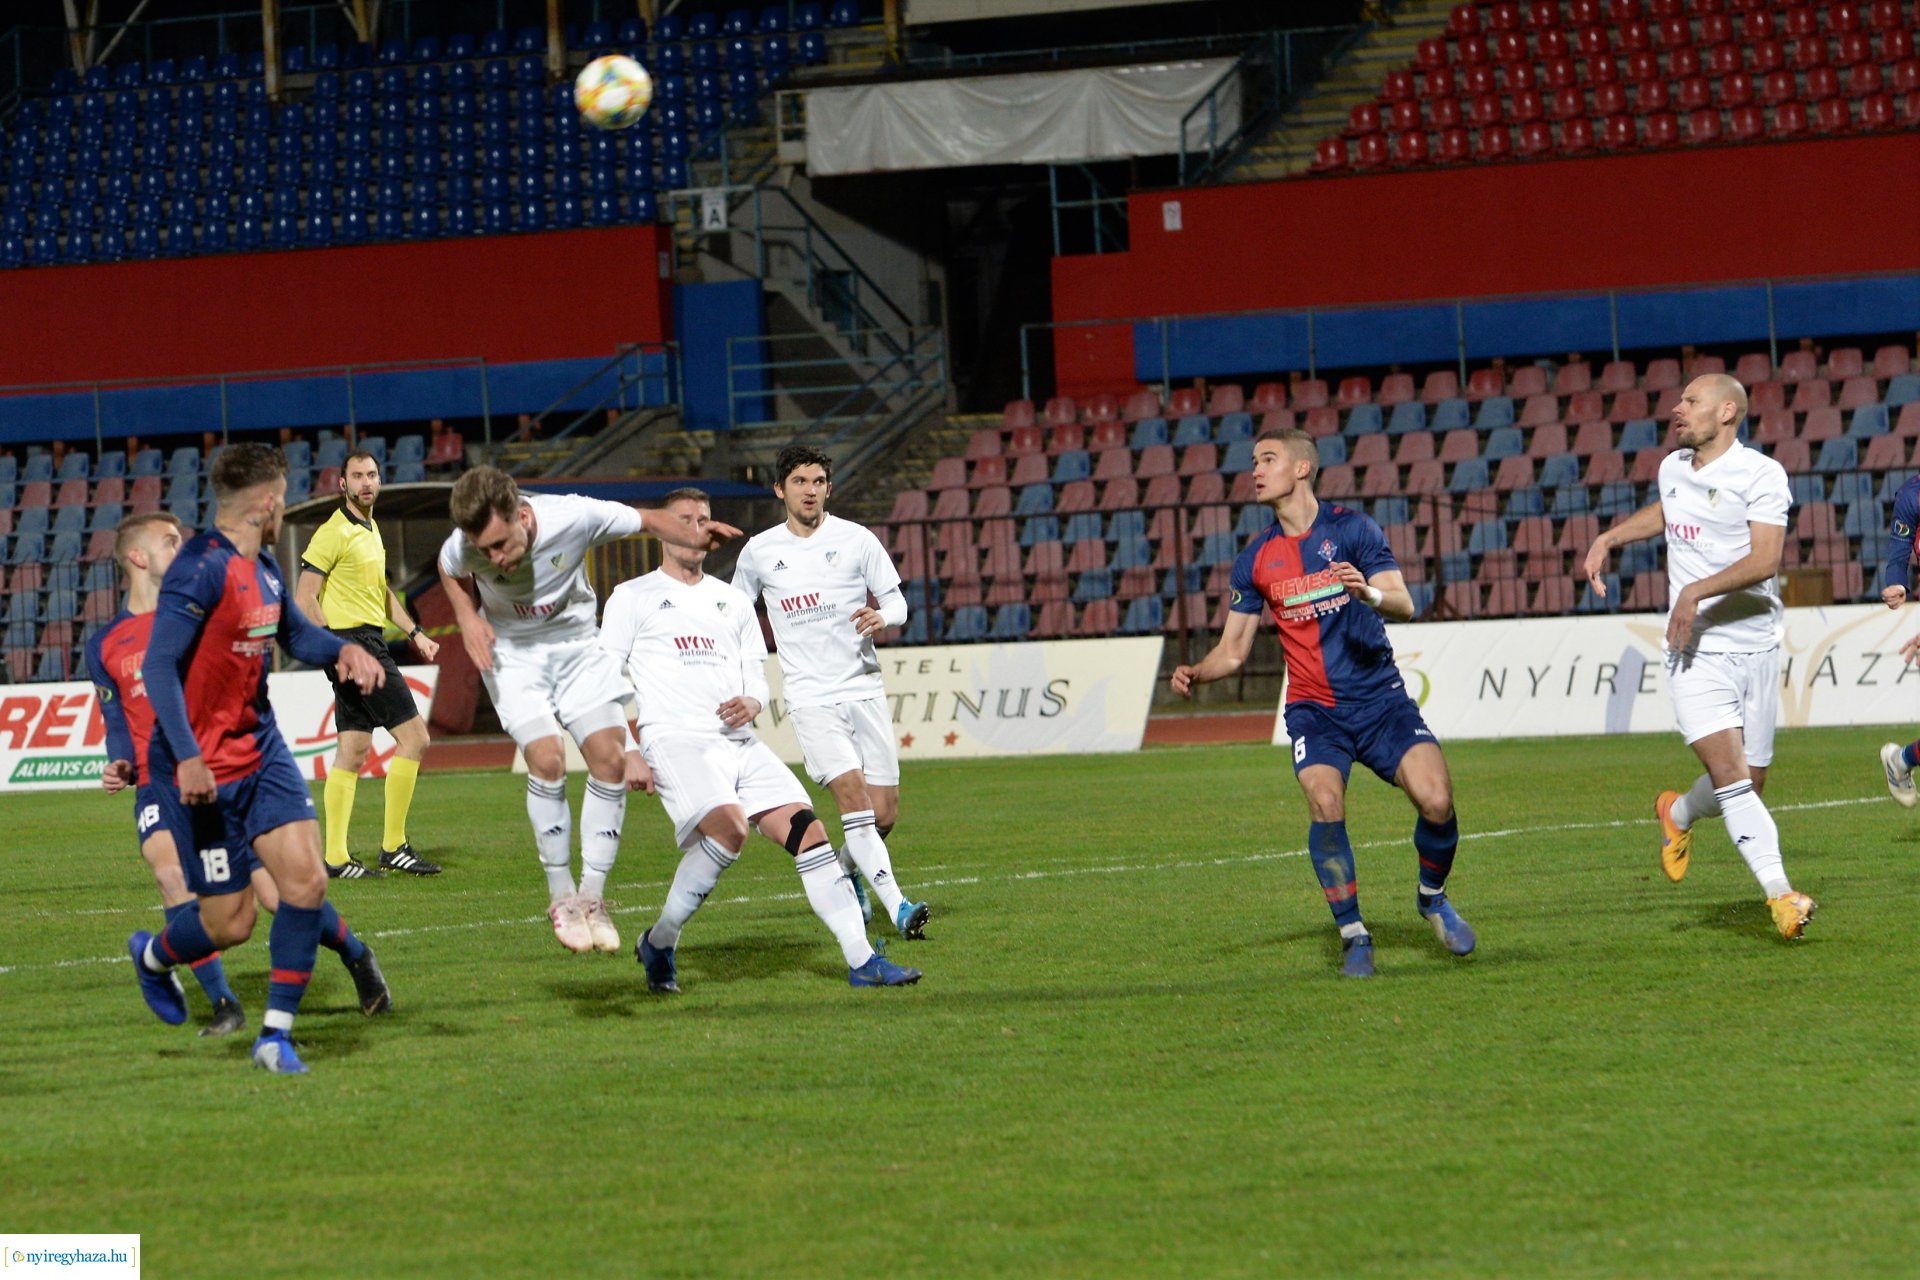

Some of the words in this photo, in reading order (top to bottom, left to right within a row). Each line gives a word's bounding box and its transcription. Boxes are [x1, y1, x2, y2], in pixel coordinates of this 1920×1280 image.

[709, 208, 721, 226] A
[787, 602, 837, 619] automotive
[894, 658, 962, 675] TEL
[1295, 735, 1306, 764] 6
[16, 761, 82, 778] ALWAYS
[83, 760, 109, 775] ON
[200, 848, 231, 883] 18
